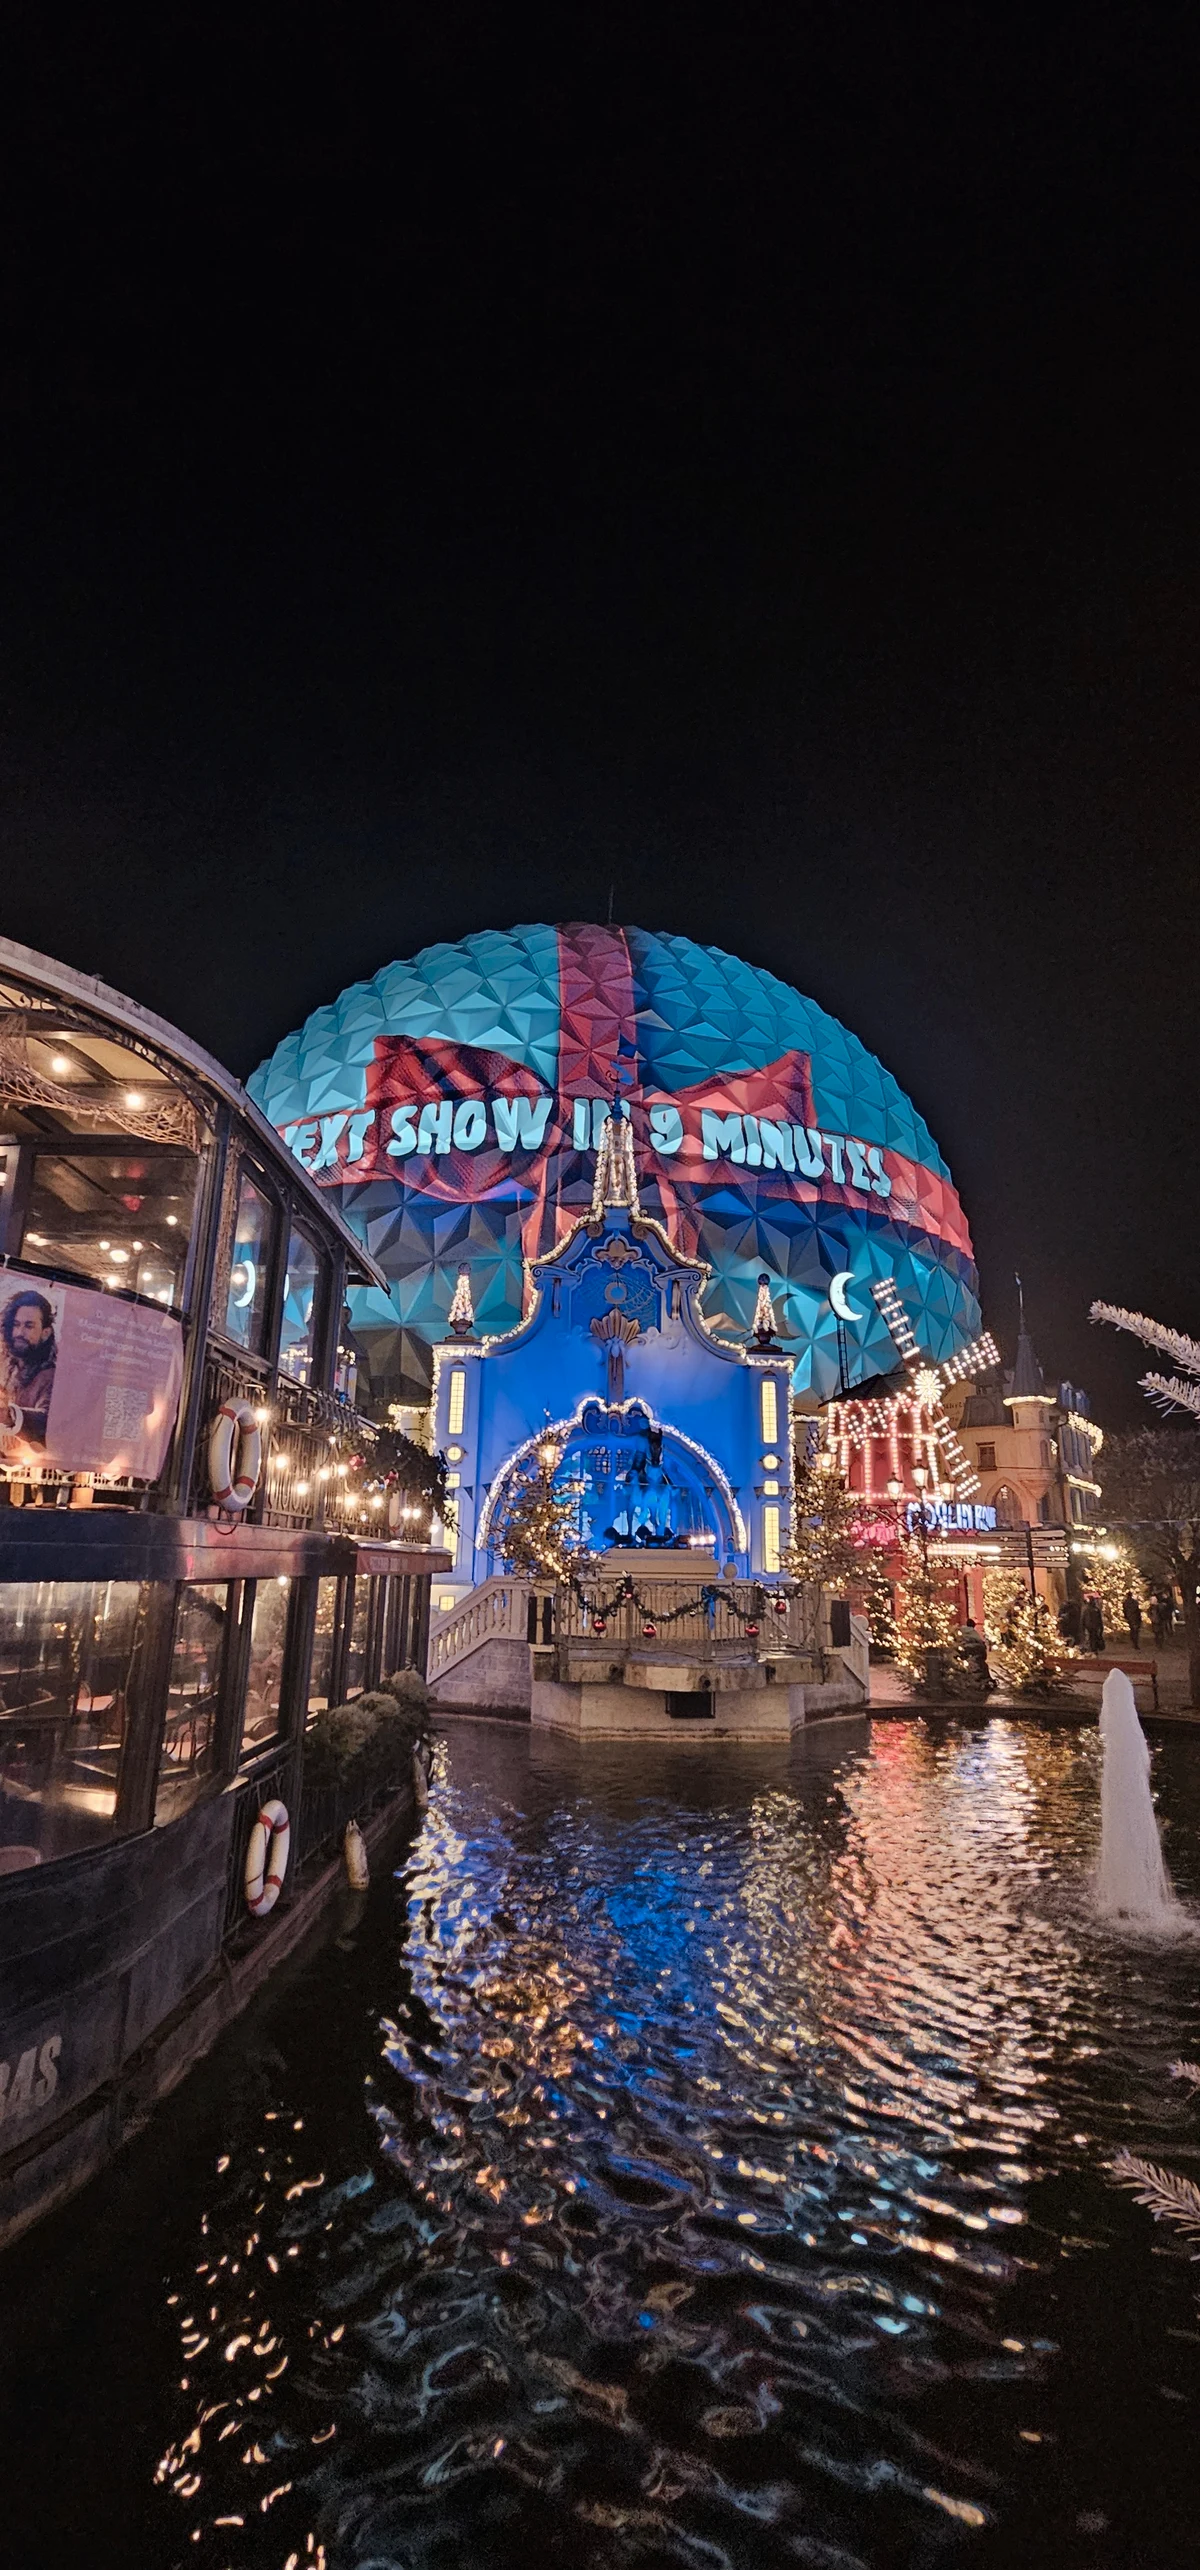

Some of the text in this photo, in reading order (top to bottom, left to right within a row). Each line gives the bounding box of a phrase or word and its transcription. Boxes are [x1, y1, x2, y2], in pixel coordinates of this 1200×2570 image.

[385, 1096, 554, 1157] SHOW
[649, 1104, 683, 1155] 9
[701, 1107, 892, 1197] MINUTES
